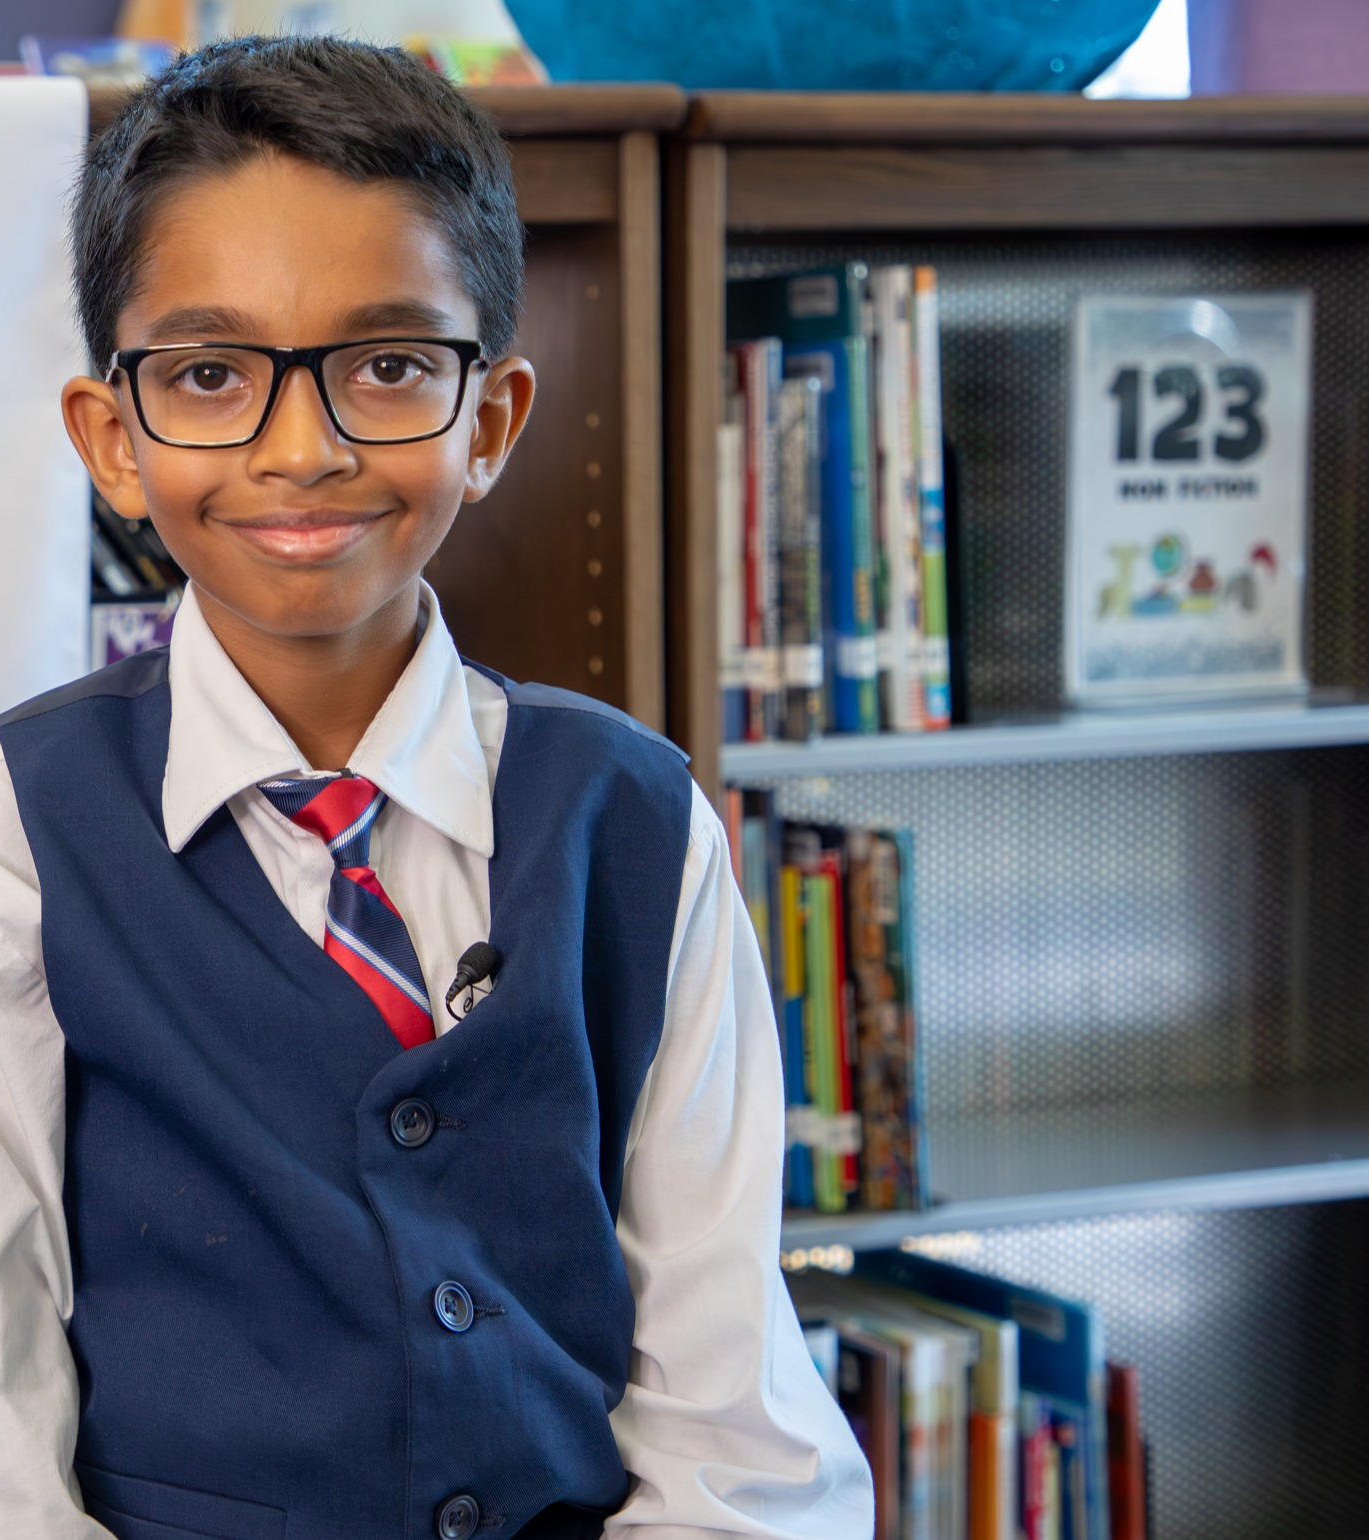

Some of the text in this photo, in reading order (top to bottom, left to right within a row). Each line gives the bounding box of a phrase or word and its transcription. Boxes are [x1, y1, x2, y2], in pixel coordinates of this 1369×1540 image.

[1107, 364, 1267, 463] 123
[1119, 474, 1258, 498] NON FICTION
